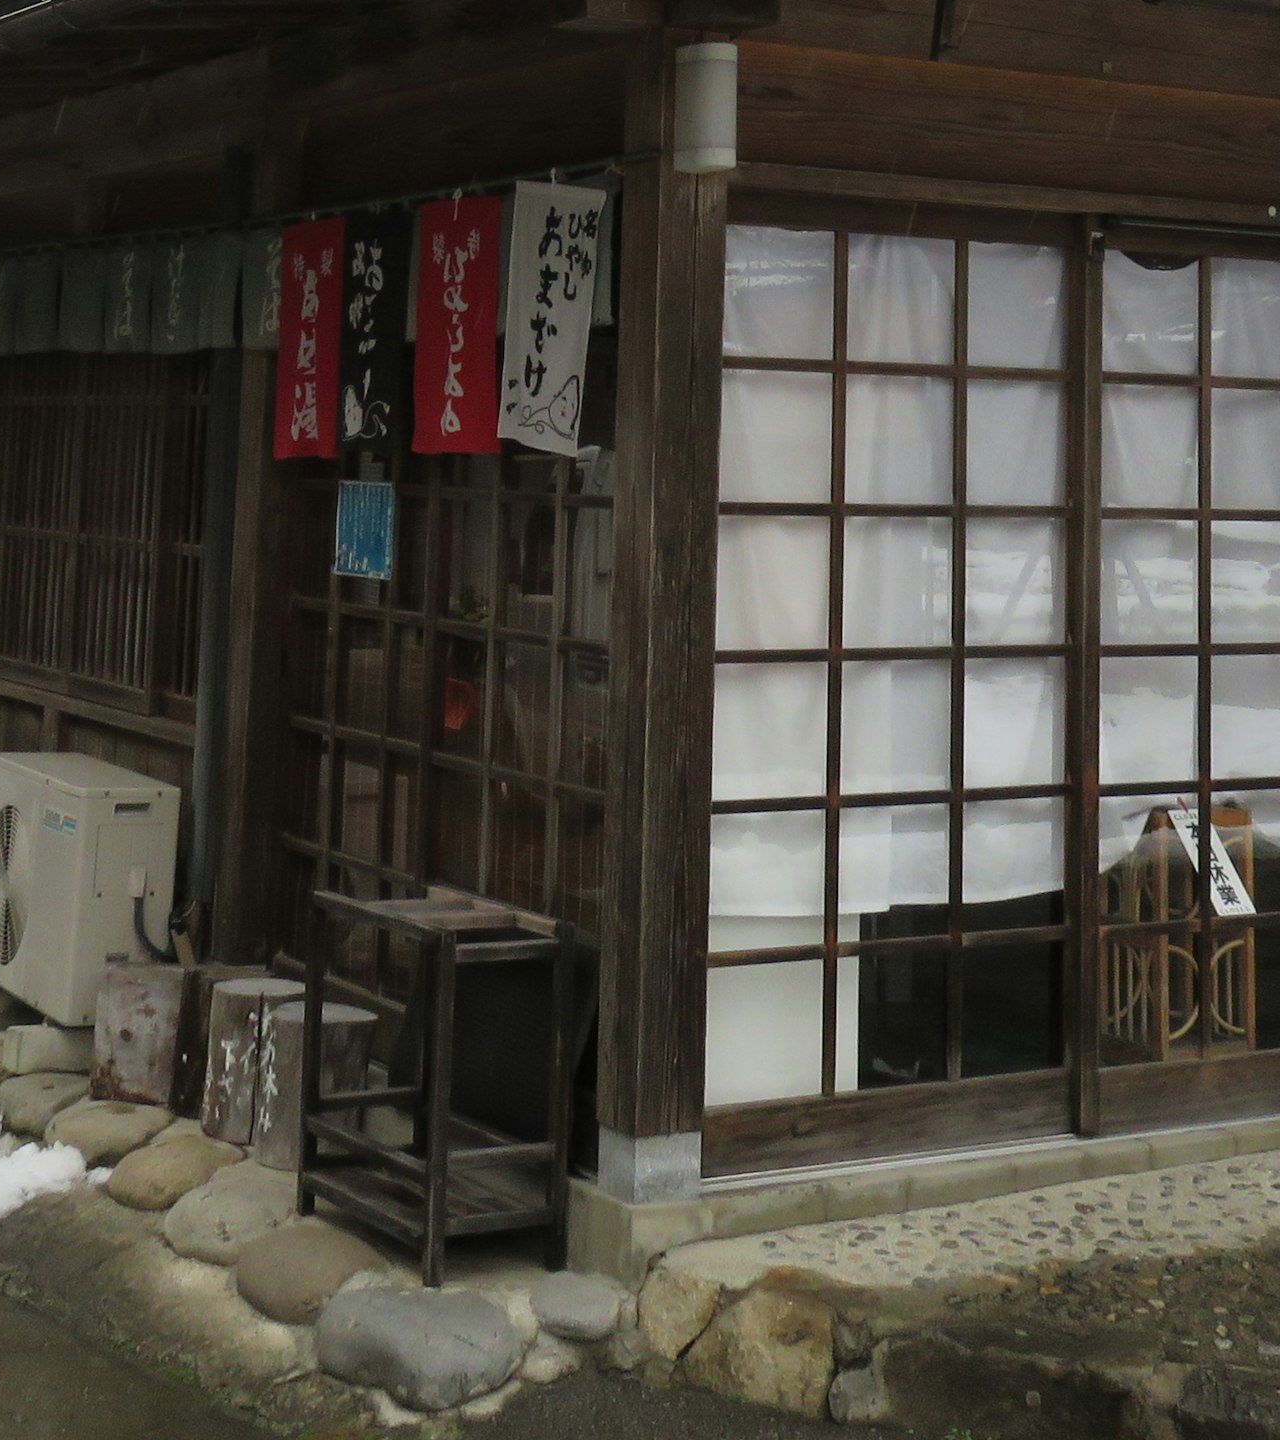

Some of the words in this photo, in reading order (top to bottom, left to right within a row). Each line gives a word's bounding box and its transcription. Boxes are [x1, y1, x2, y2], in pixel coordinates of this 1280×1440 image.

[525, 206, 562, 397] あまざけ
[562, 213, 582, 301] ひやし
